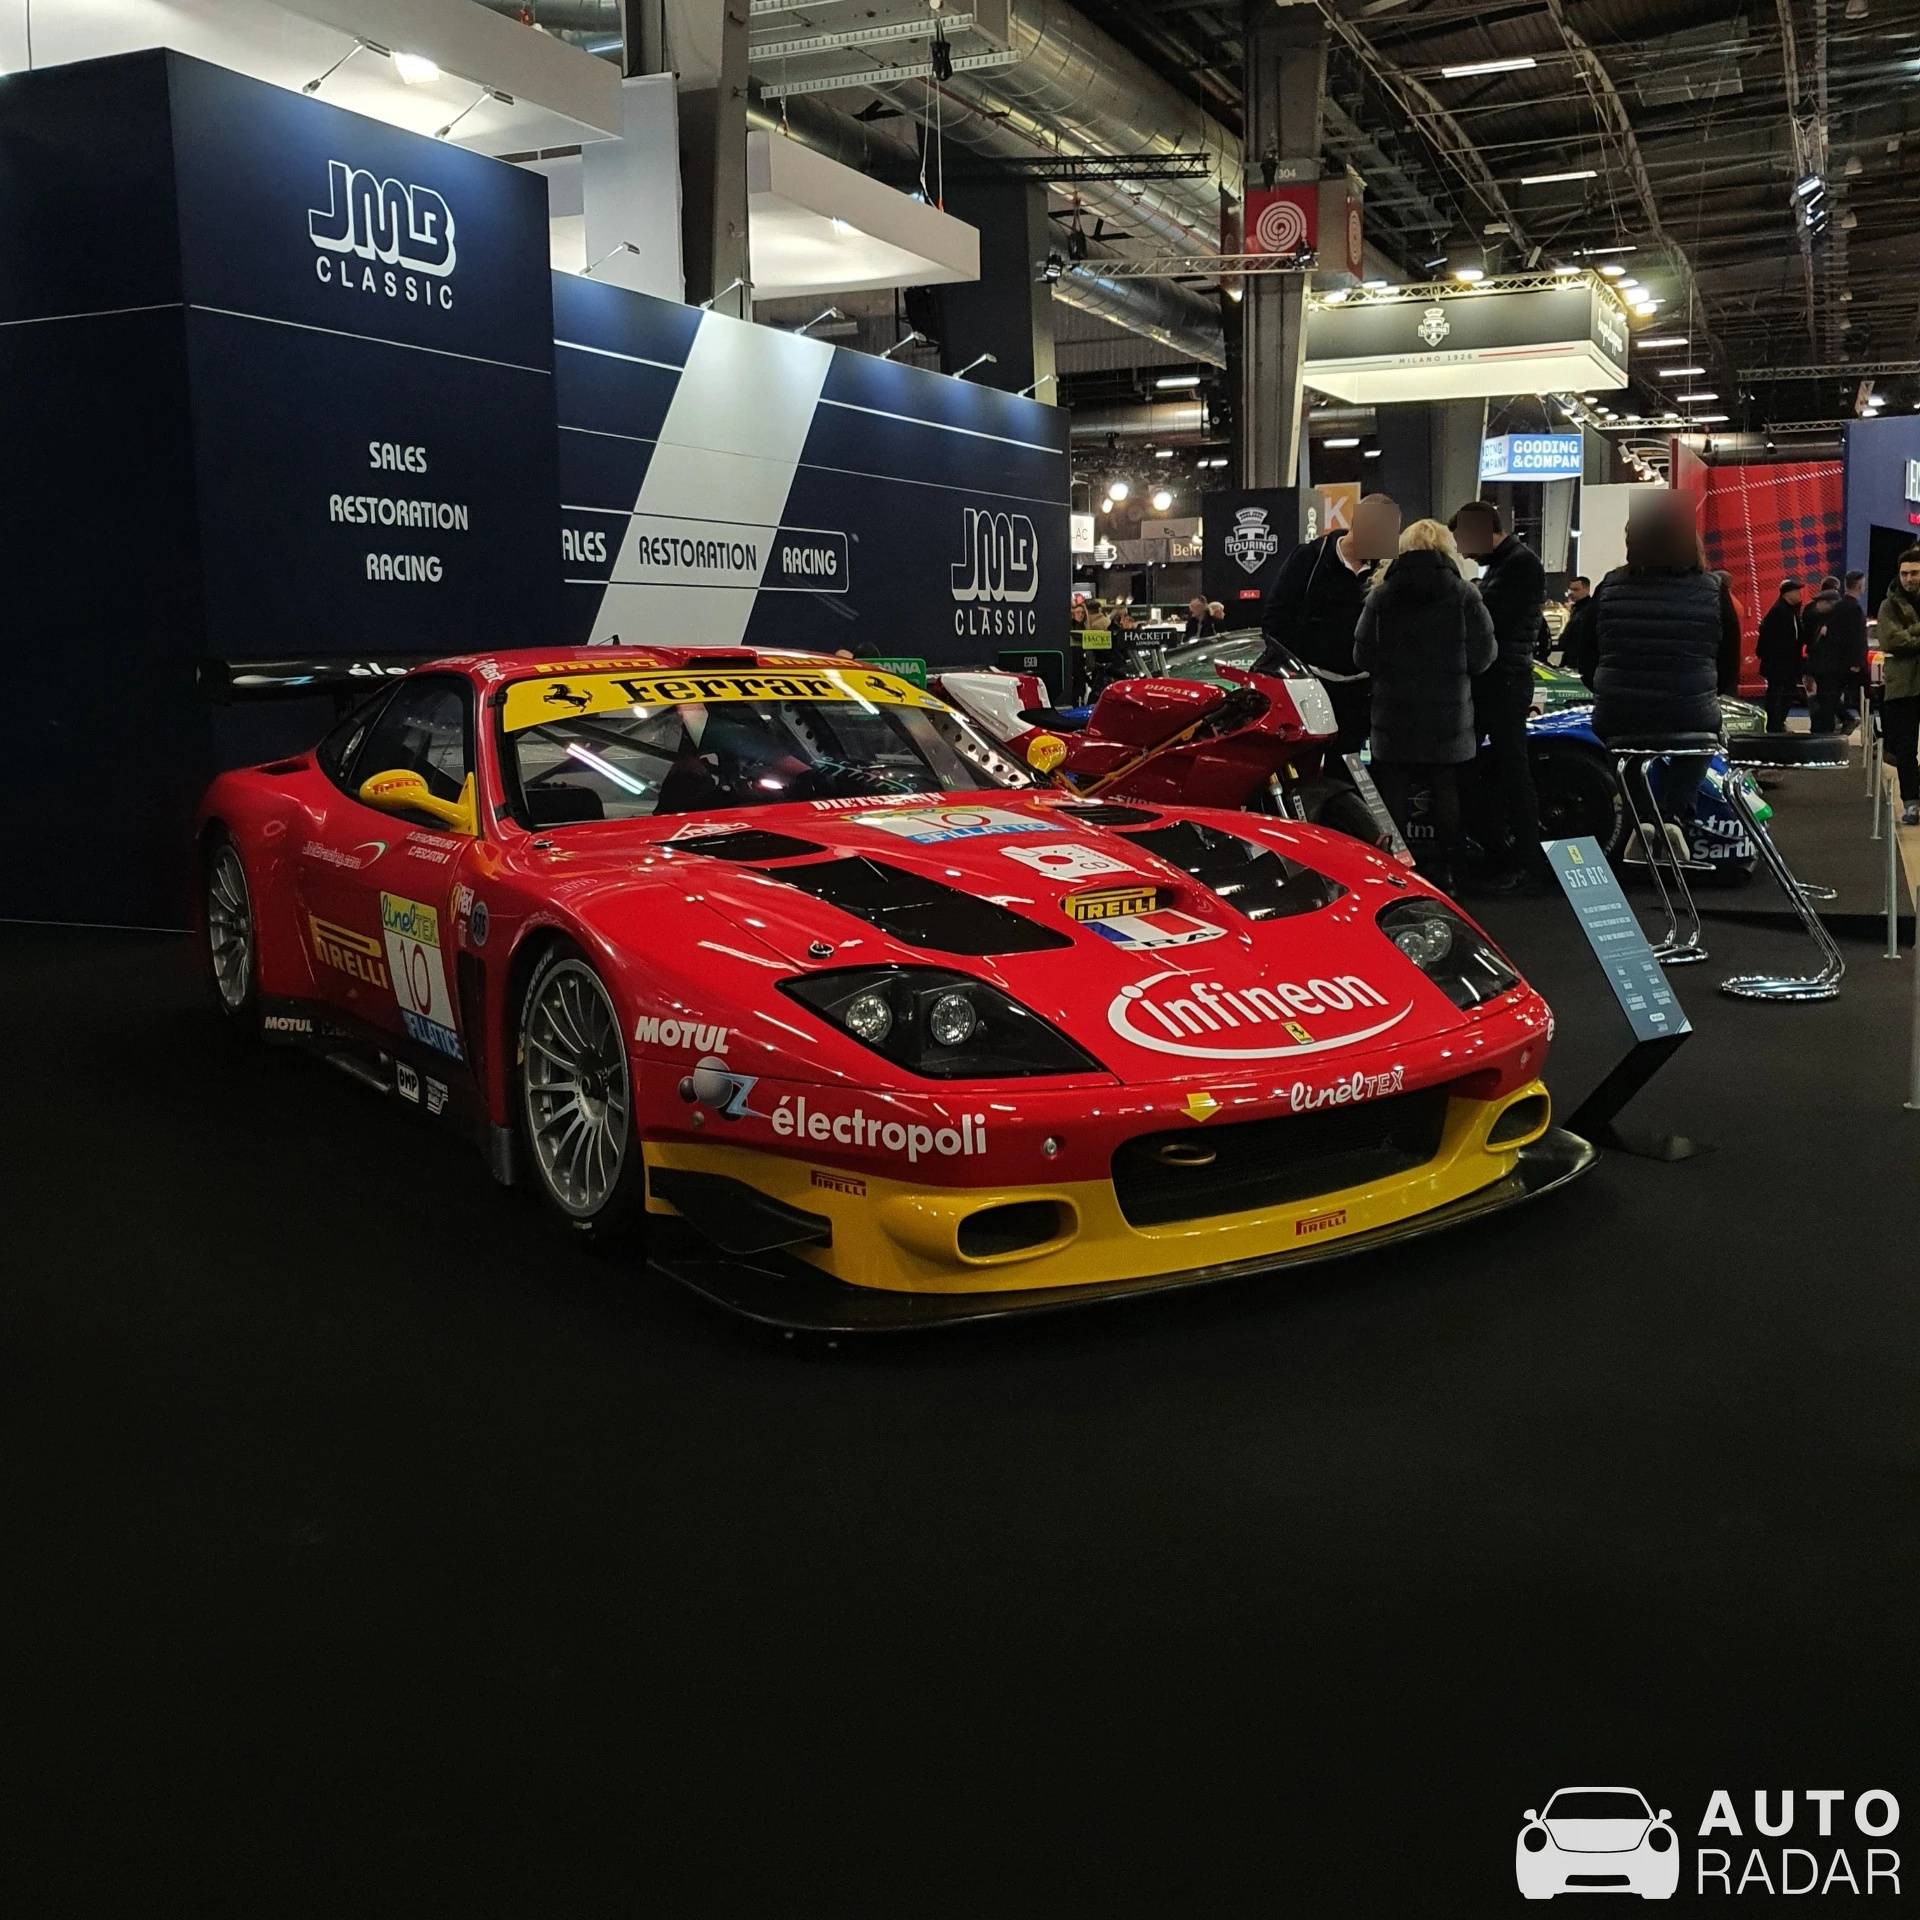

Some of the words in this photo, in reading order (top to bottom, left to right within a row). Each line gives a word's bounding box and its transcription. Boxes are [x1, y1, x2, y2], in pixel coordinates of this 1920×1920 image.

[308, 159, 457, 278] JMB
[316, 256, 453, 309] CLASSIC
[1399, 355, 1441, 364] MILANO
[369, 441, 427, 473] SALES
[1513, 440, 1578, 454] GOODING
[1513, 454, 1582, 468] &COMPAN
[329, 494, 468, 531] RESTORATION
[1324, 496, 1349, 529] K
[562, 529, 606, 562] ALES
[639, 535, 757, 571] RESTORATION
[782, 547, 837, 576] RACING
[951, 507, 1038, 602] JMB
[1228, 540, 1274, 553] TOURING
[366, 553, 443, 582] RACING
[955, 608, 1036, 636] CLASSIC
[1124, 631, 1171, 643] HACKETT
[609, 673, 849, 704] Ferrar
[908, 812, 991, 829] 10
[1692, 836, 1756, 860] Sarth
[1080, 861, 1110, 870] CD
[1564, 867, 1587, 888] 575
[1588, 865, 1609, 884] GTC
[1065, 887, 1156, 920] PIRELLI
[309, 914, 388, 990] PIRELLI
[399, 939, 432, 1017] 10
[264, 1016, 313, 1033] MOTUL
[635, 1015, 729, 1054] MOTUL
[400, 1068, 417, 1094] OMP
[772, 1095, 987, 1163] électropoli
[811, 1170, 867, 1197] PIRELLI
[1295, 1209, 1347, 1236] PIRELLI
